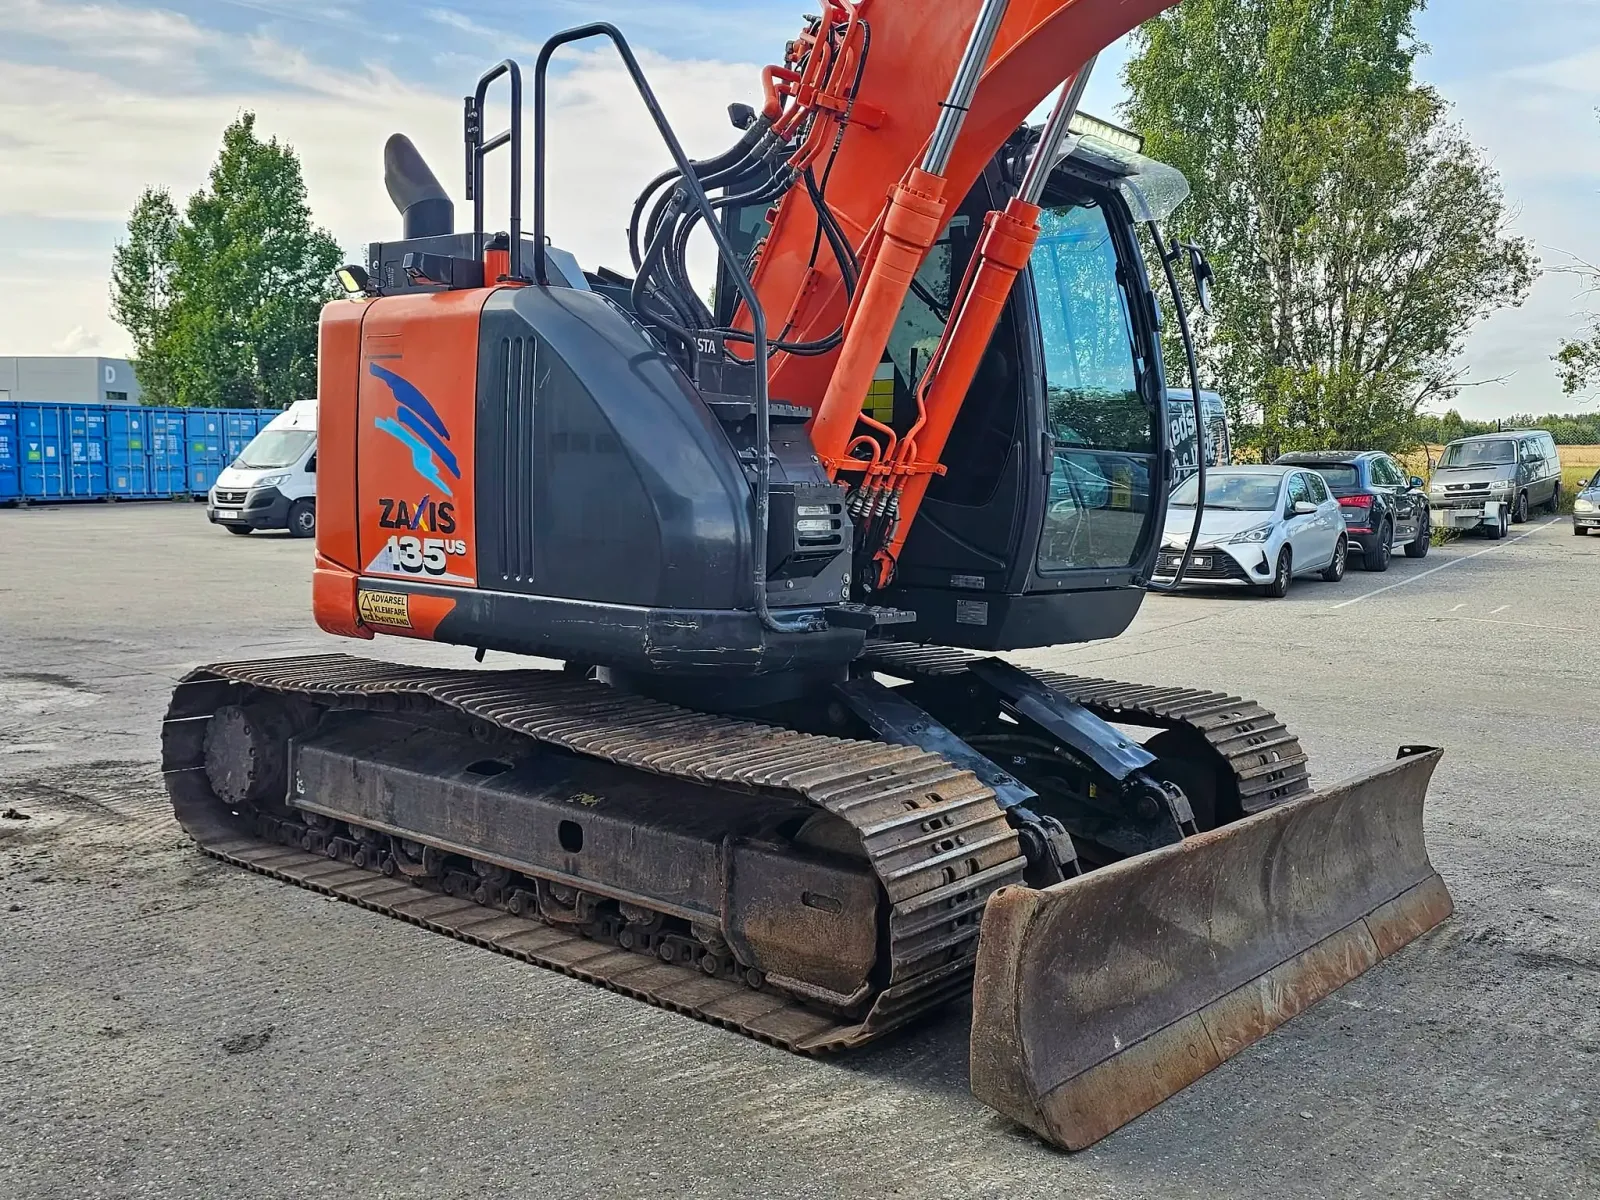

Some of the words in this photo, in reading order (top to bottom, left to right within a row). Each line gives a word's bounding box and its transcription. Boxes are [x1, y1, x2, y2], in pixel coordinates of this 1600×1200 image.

[105, 365, 116, 384] D
[379, 493, 456, 534] ZAXIS
[371, 593, 406, 606] ADVARSEL
[373, 605, 407, 617] KLEMFARE
